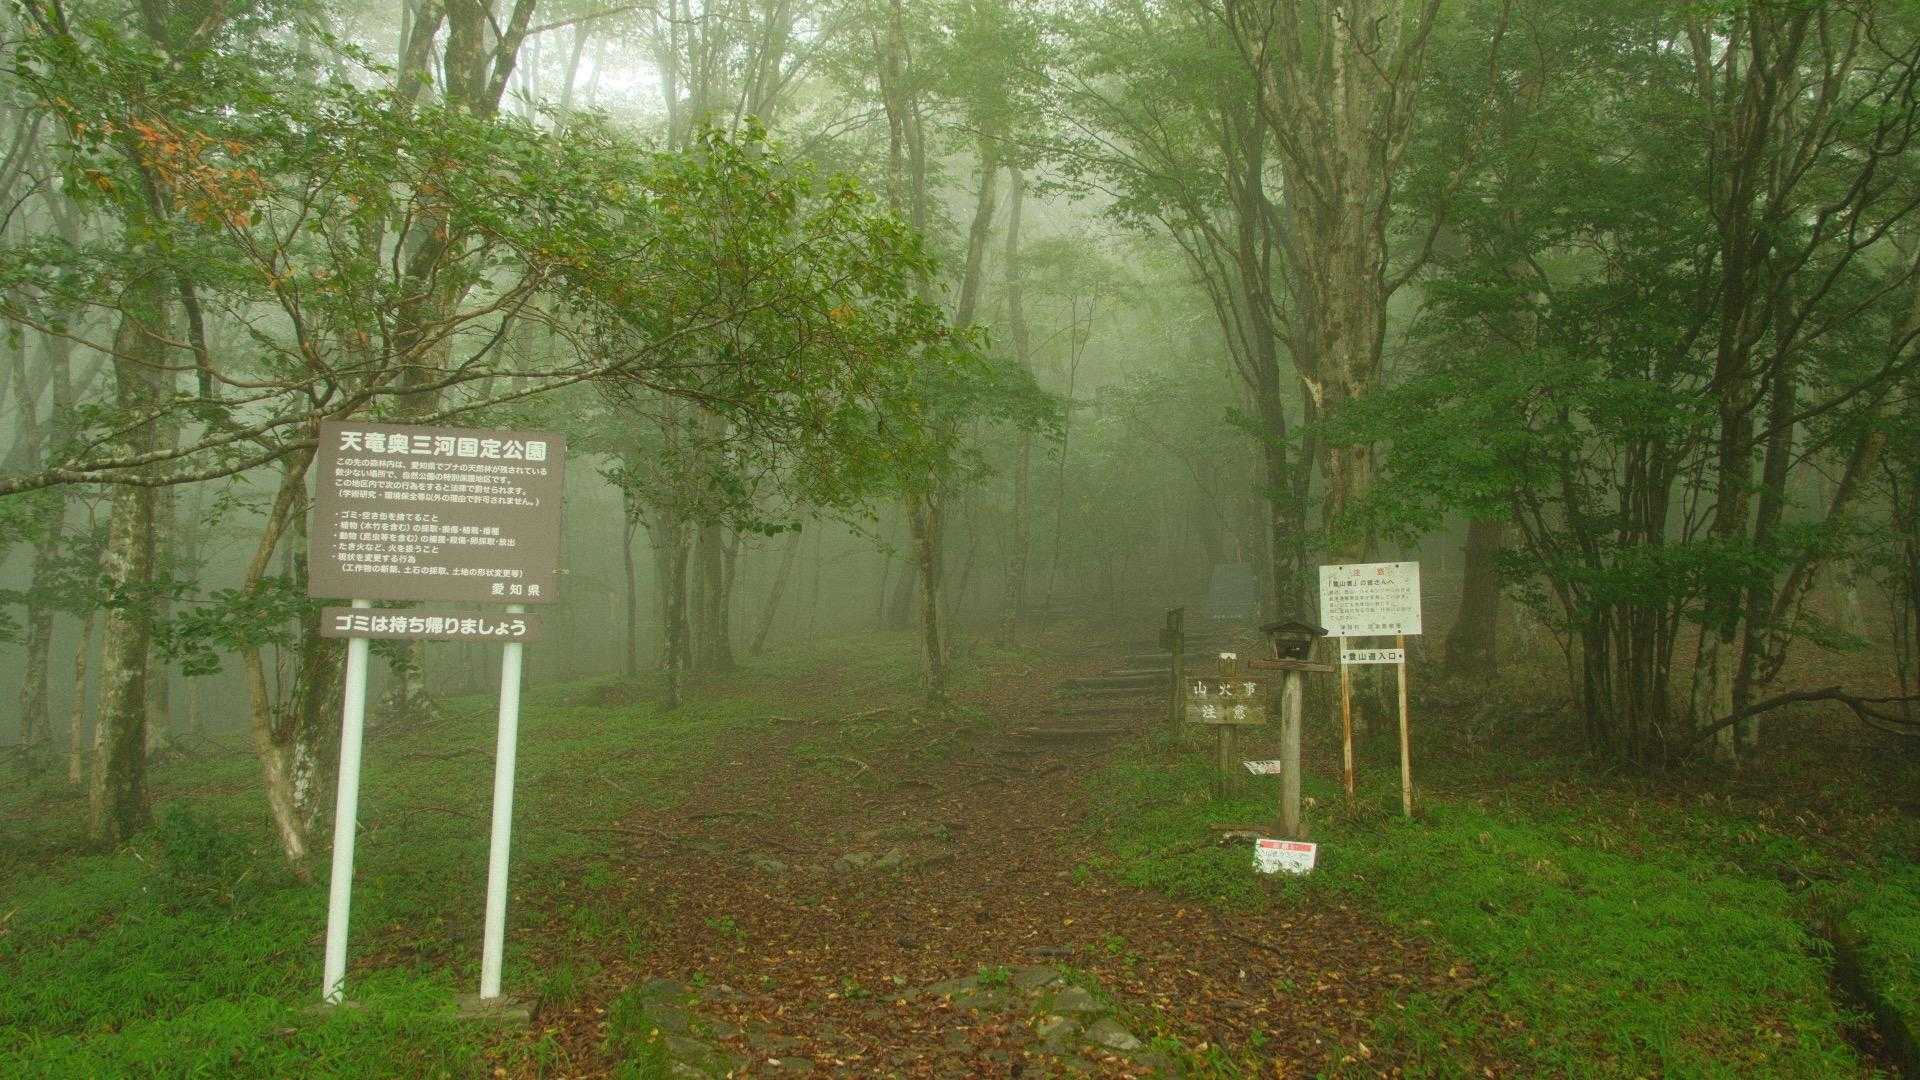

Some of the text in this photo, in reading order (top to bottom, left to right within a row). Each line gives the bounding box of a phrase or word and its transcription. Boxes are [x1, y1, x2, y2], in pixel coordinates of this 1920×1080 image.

[339, 430, 548, 462] 天竜奥三河国定公園
[335, 614, 528, 637] ゴミは持ち帰りましょう
[1347, 651, 1397, 661] 登山道入口
